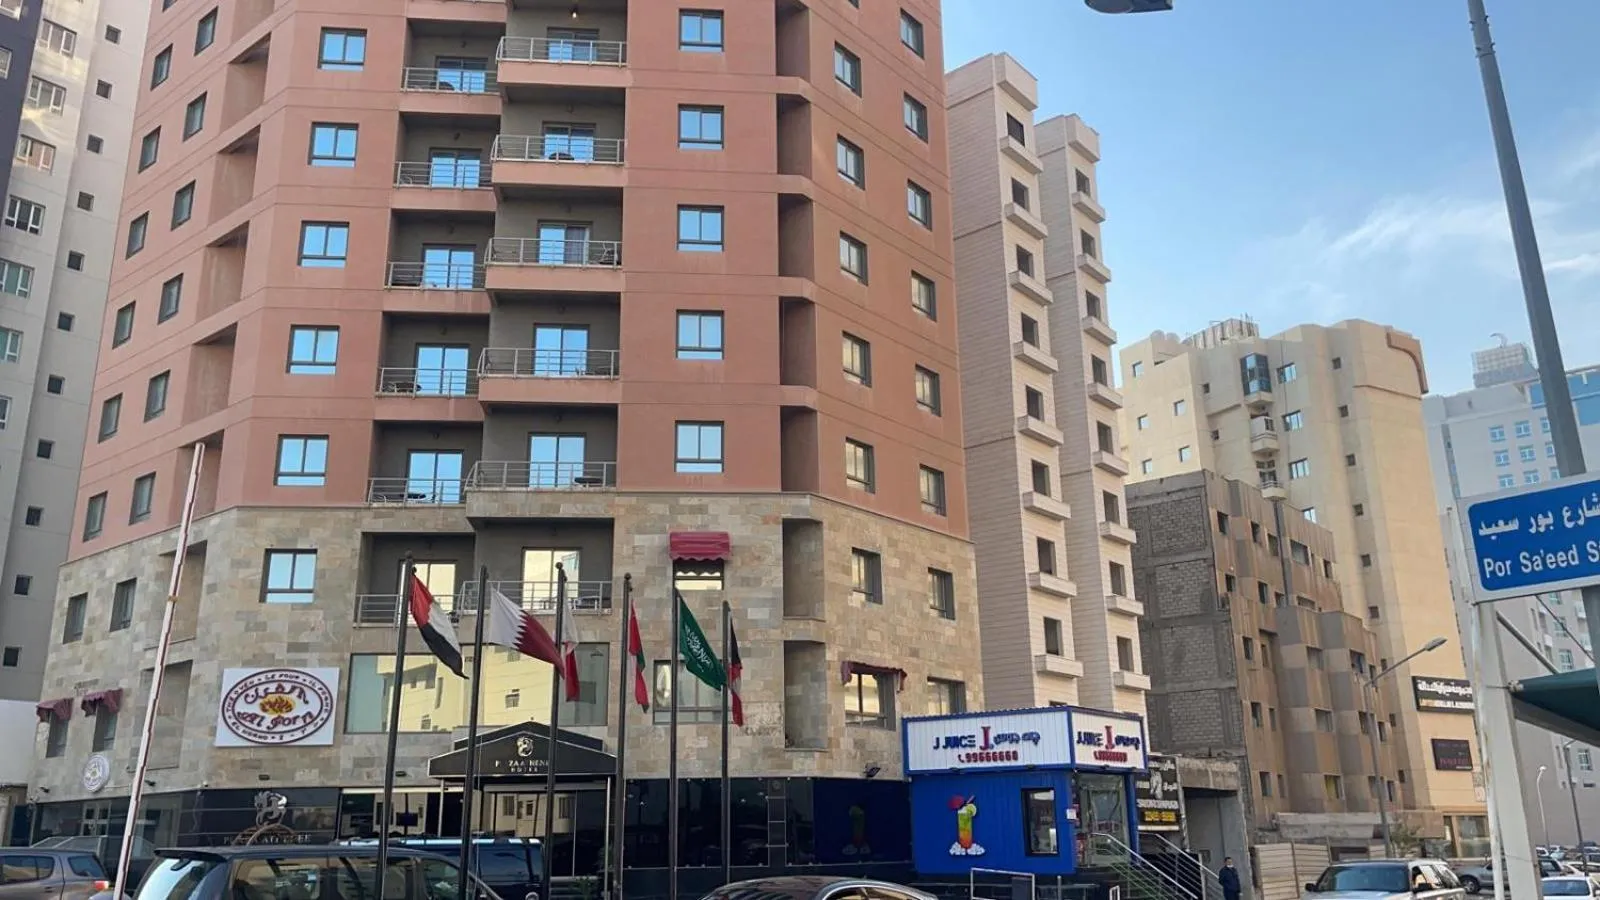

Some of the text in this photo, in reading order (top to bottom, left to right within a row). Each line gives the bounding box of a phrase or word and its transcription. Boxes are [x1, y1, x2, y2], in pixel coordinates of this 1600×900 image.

[1478, 518, 1519, 540] سعيد
[1529, 510, 1554, 533] بور
[1483, 540, 1600, 578] Por Sa'eed S
